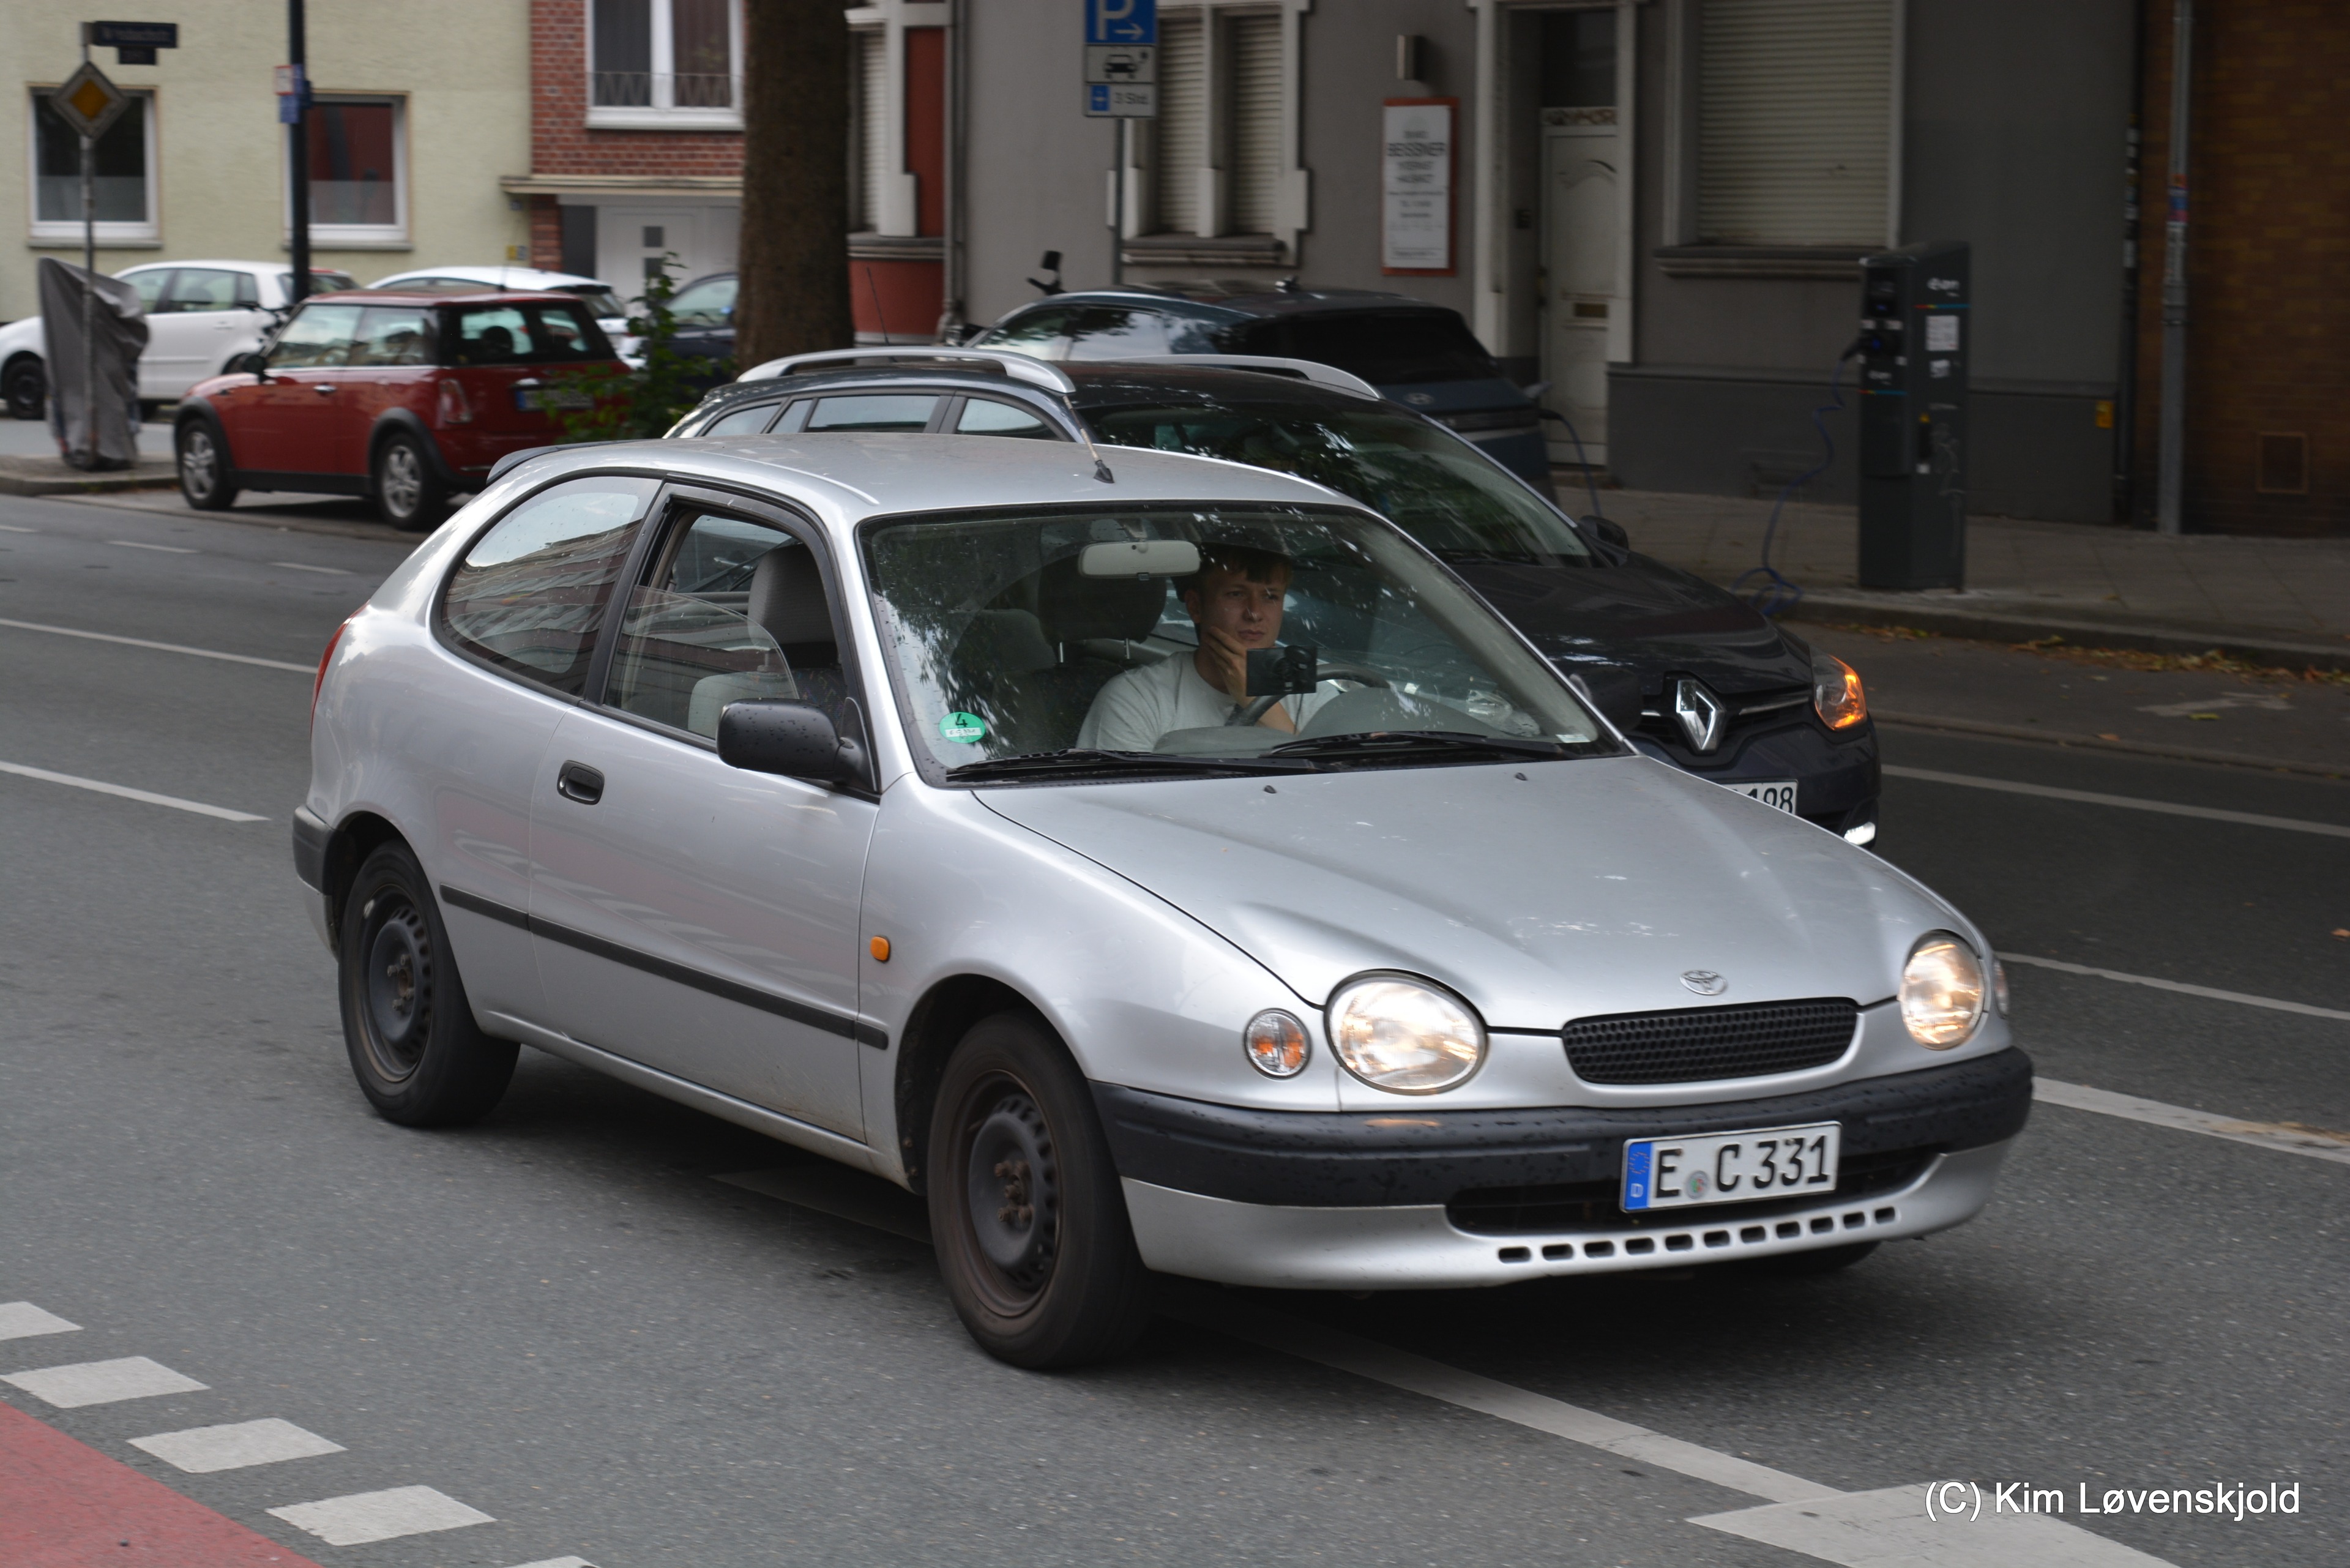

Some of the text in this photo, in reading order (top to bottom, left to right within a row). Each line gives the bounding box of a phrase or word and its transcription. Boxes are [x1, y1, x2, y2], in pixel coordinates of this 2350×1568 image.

[1097, 0, 1135, 40] P
[955, 713, 968, 727] 4
[1655, 1148, 1682, 1198] E
[1753, 1135, 1829, 1189] 331
[1630, 1183, 1644, 1198] D
